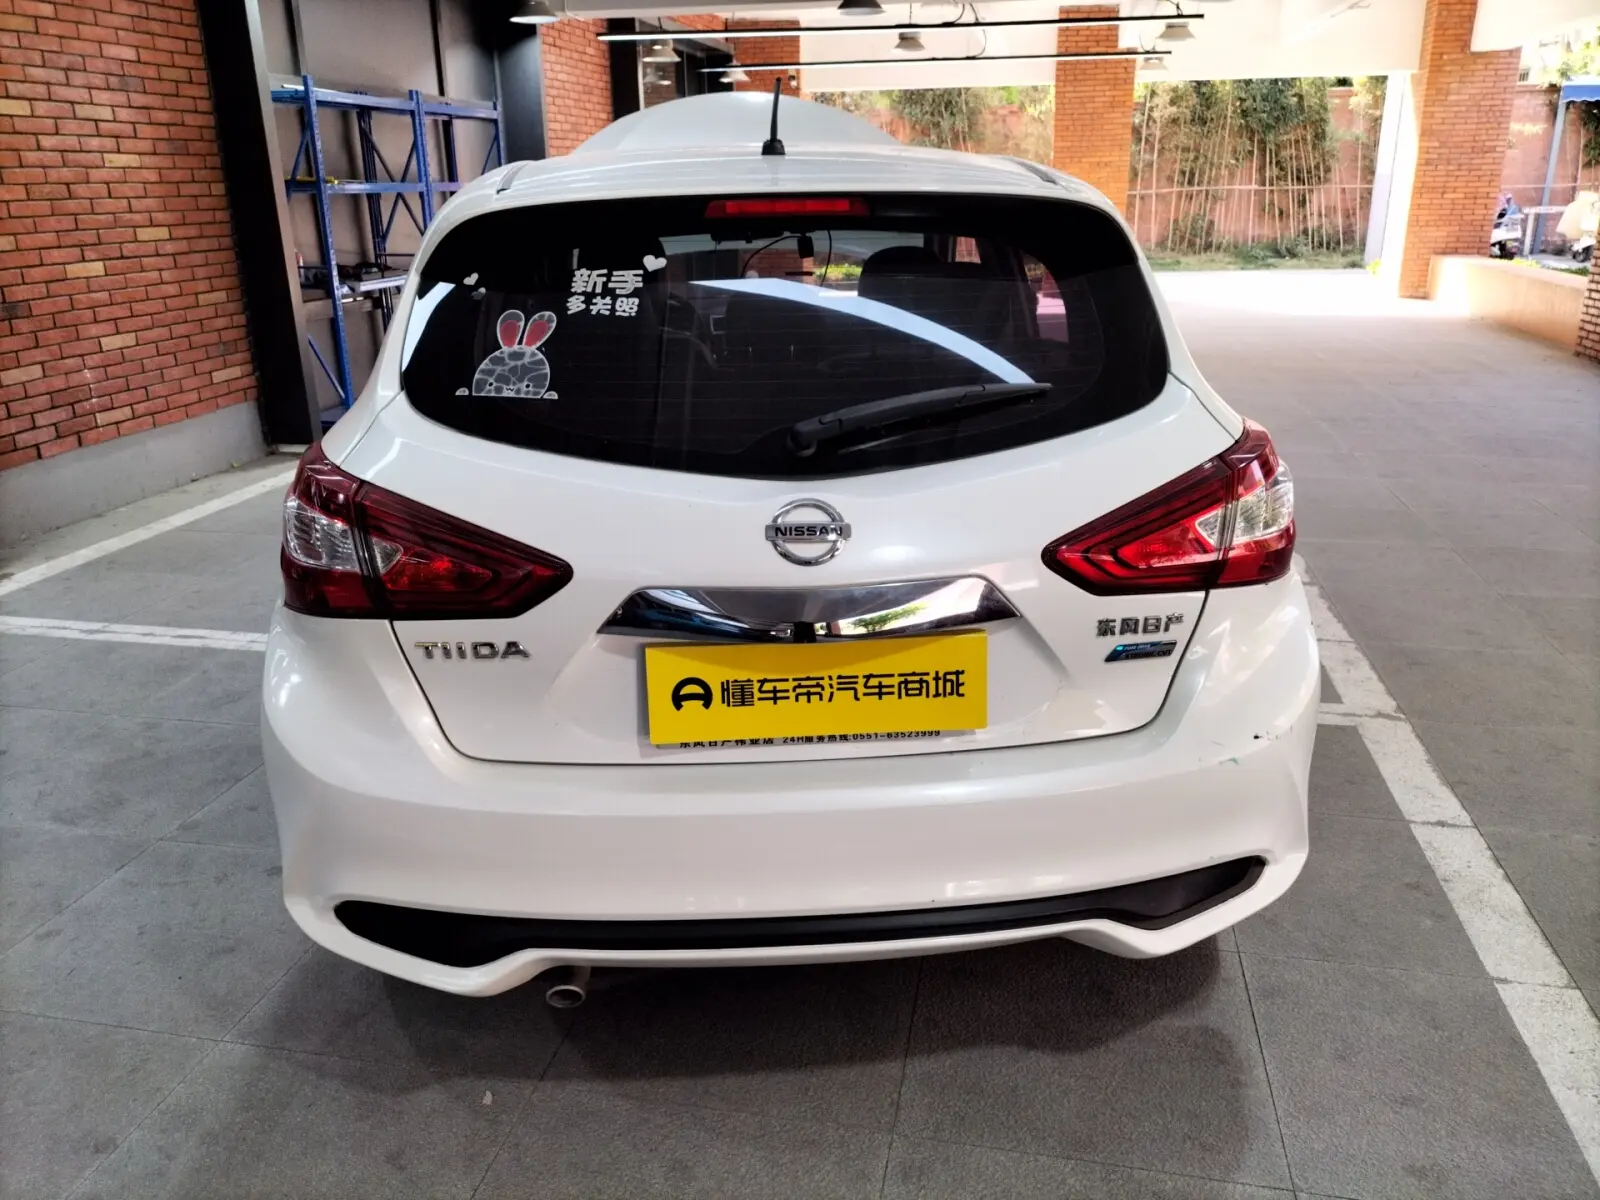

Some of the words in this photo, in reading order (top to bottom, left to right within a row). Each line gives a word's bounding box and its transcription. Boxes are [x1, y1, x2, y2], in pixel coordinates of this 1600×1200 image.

[570, 268, 644, 295] 新手
[566, 296, 640, 317] 多关照
[775, 526, 843, 537] NISSAN
[1096, 613, 1184, 637] 东风日产
[721, 669, 966, 708] 懂车帝汽车商城
